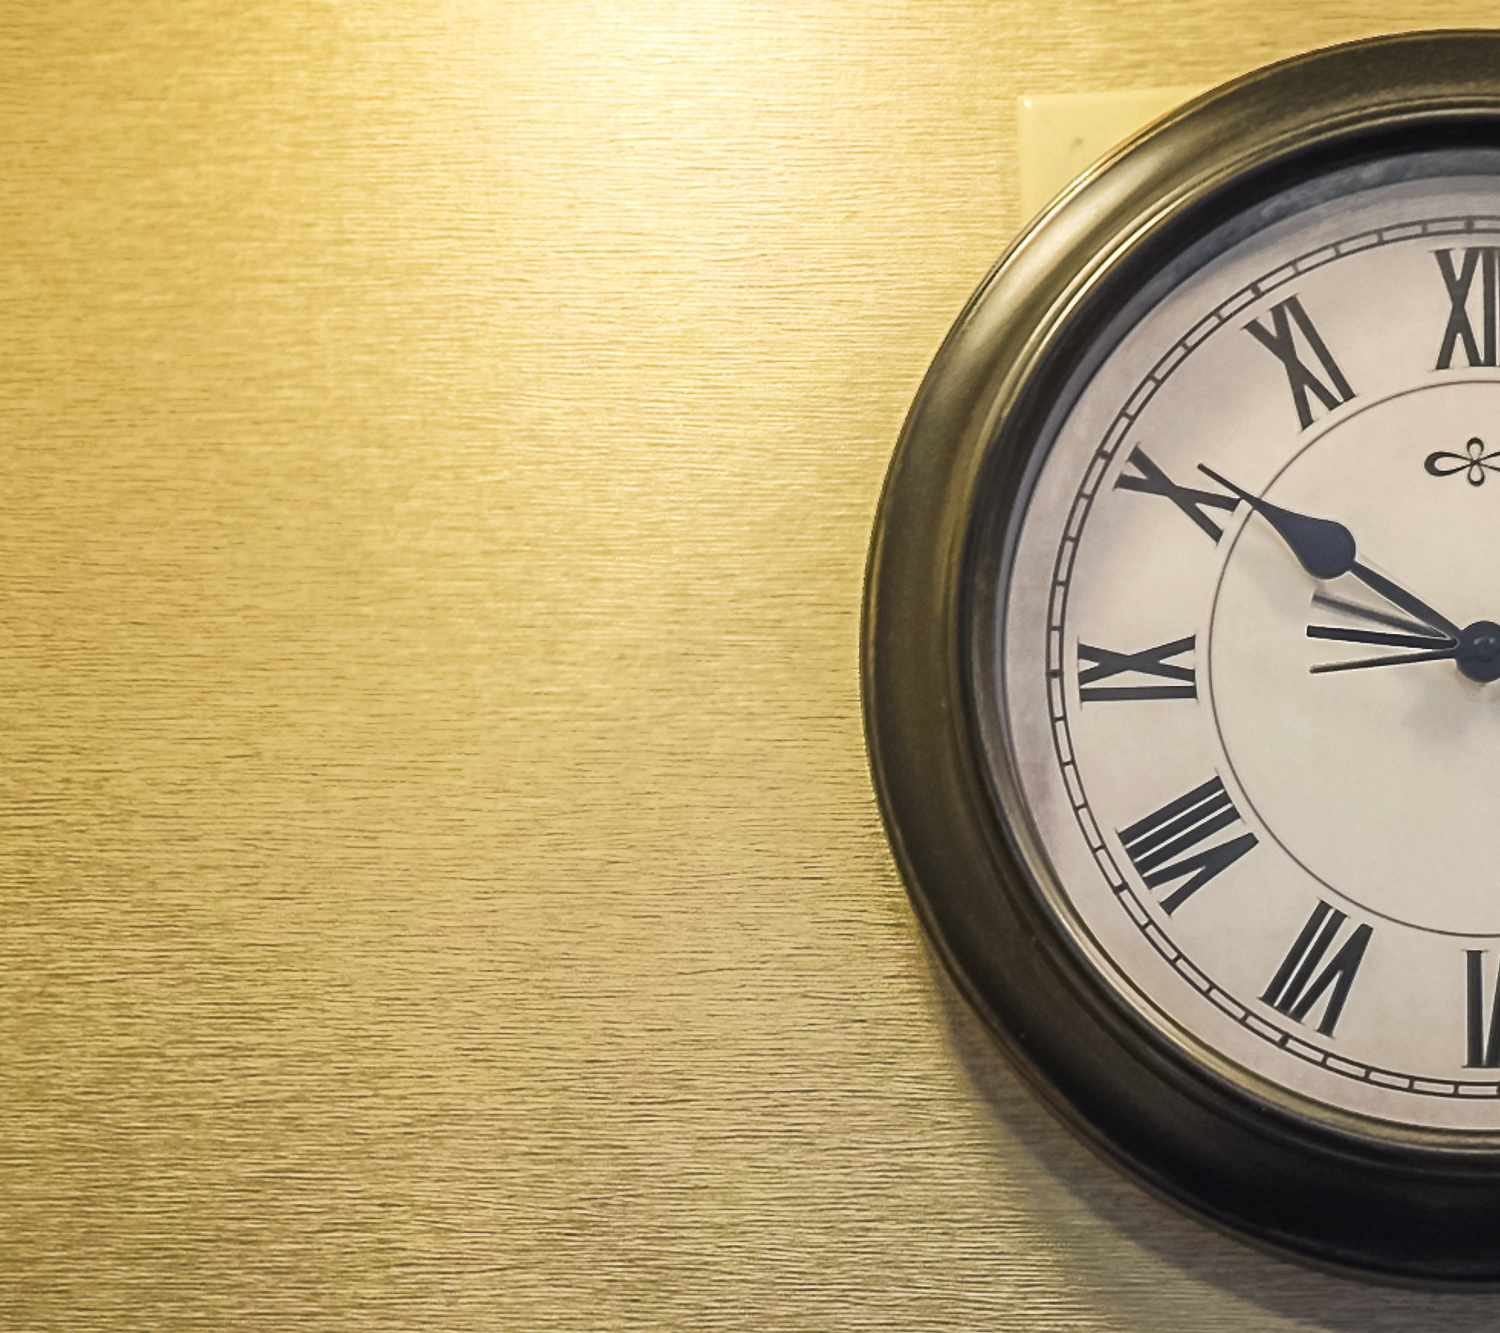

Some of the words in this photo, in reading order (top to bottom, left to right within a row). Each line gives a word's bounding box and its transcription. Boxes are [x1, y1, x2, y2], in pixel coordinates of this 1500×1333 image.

[1241, 295, 1358, 429] XI
[1078, 634, 1197, 703] IX
[1117, 774, 1259, 917] VIII
[1259, 899, 1373, 1039] VII
